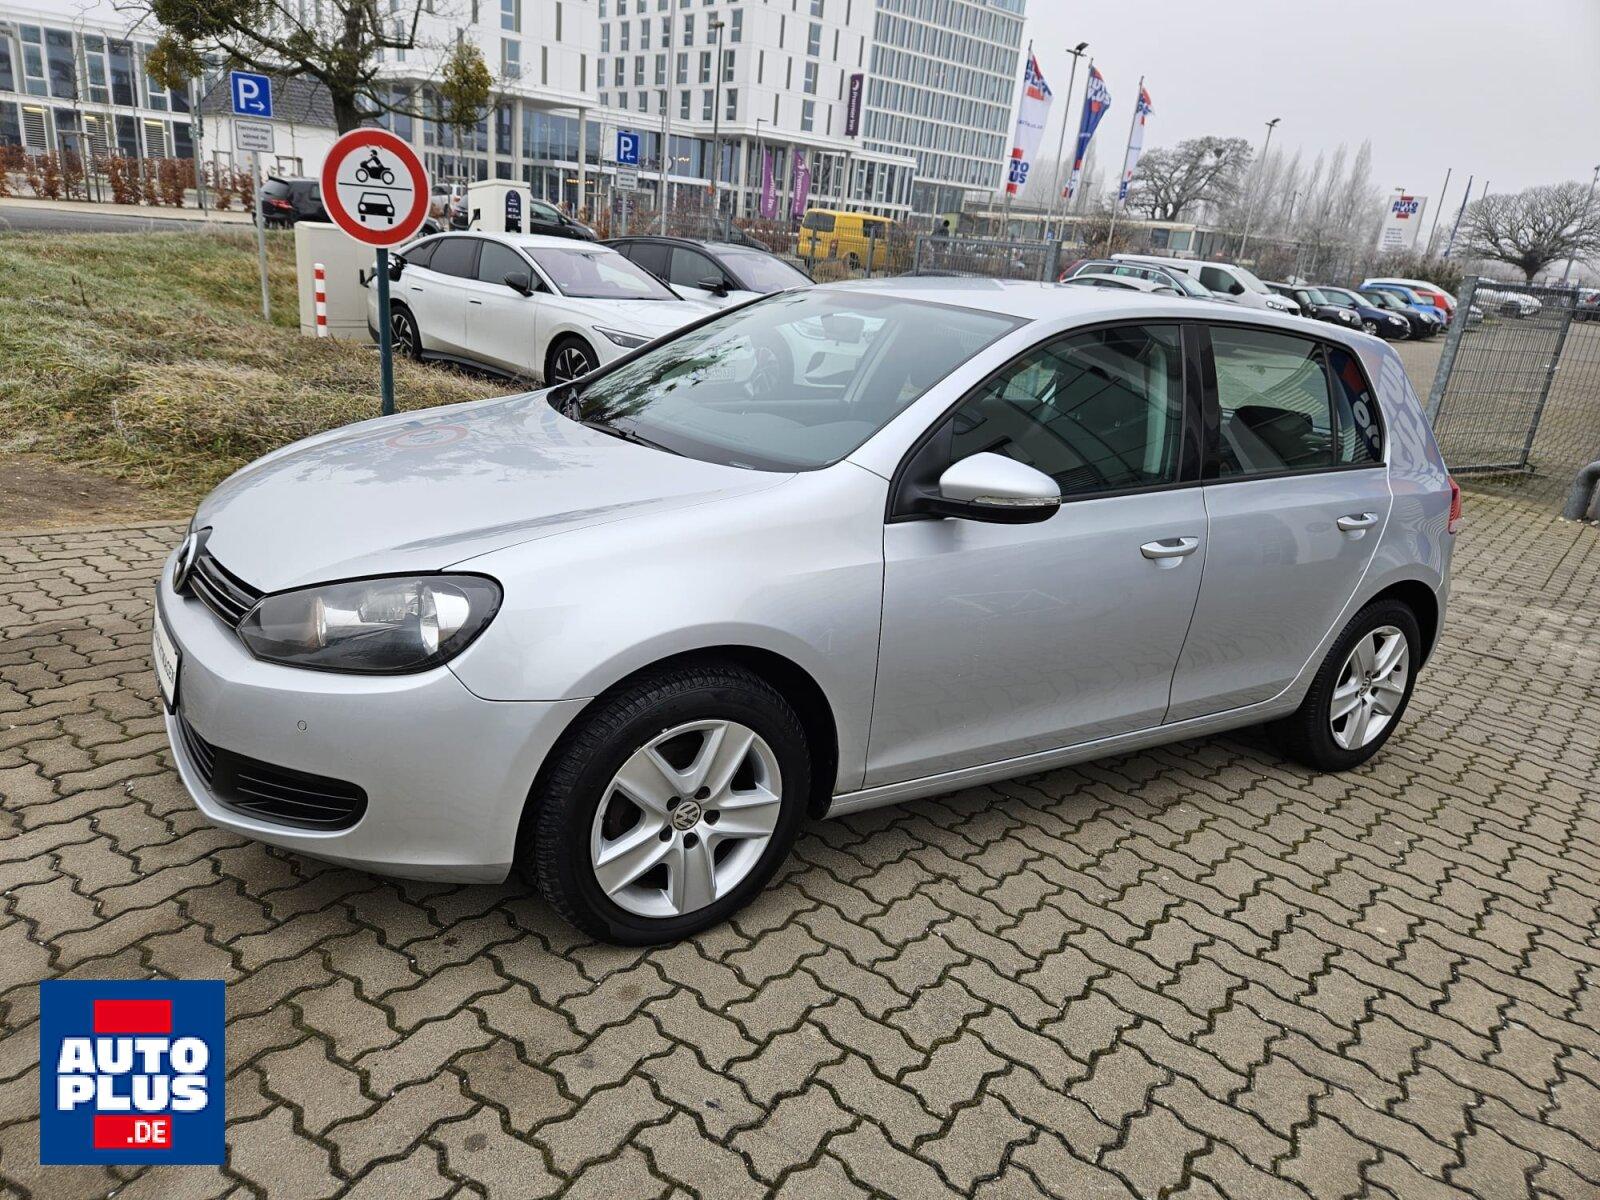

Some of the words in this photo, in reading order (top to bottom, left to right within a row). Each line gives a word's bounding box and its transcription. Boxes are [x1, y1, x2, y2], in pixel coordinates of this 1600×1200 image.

[238, 78, 259, 109] P
[620, 136, 632, 160] P
[1392, 206, 1418, 214] PLUS
[1394, 200, 1418, 209] AUTO
